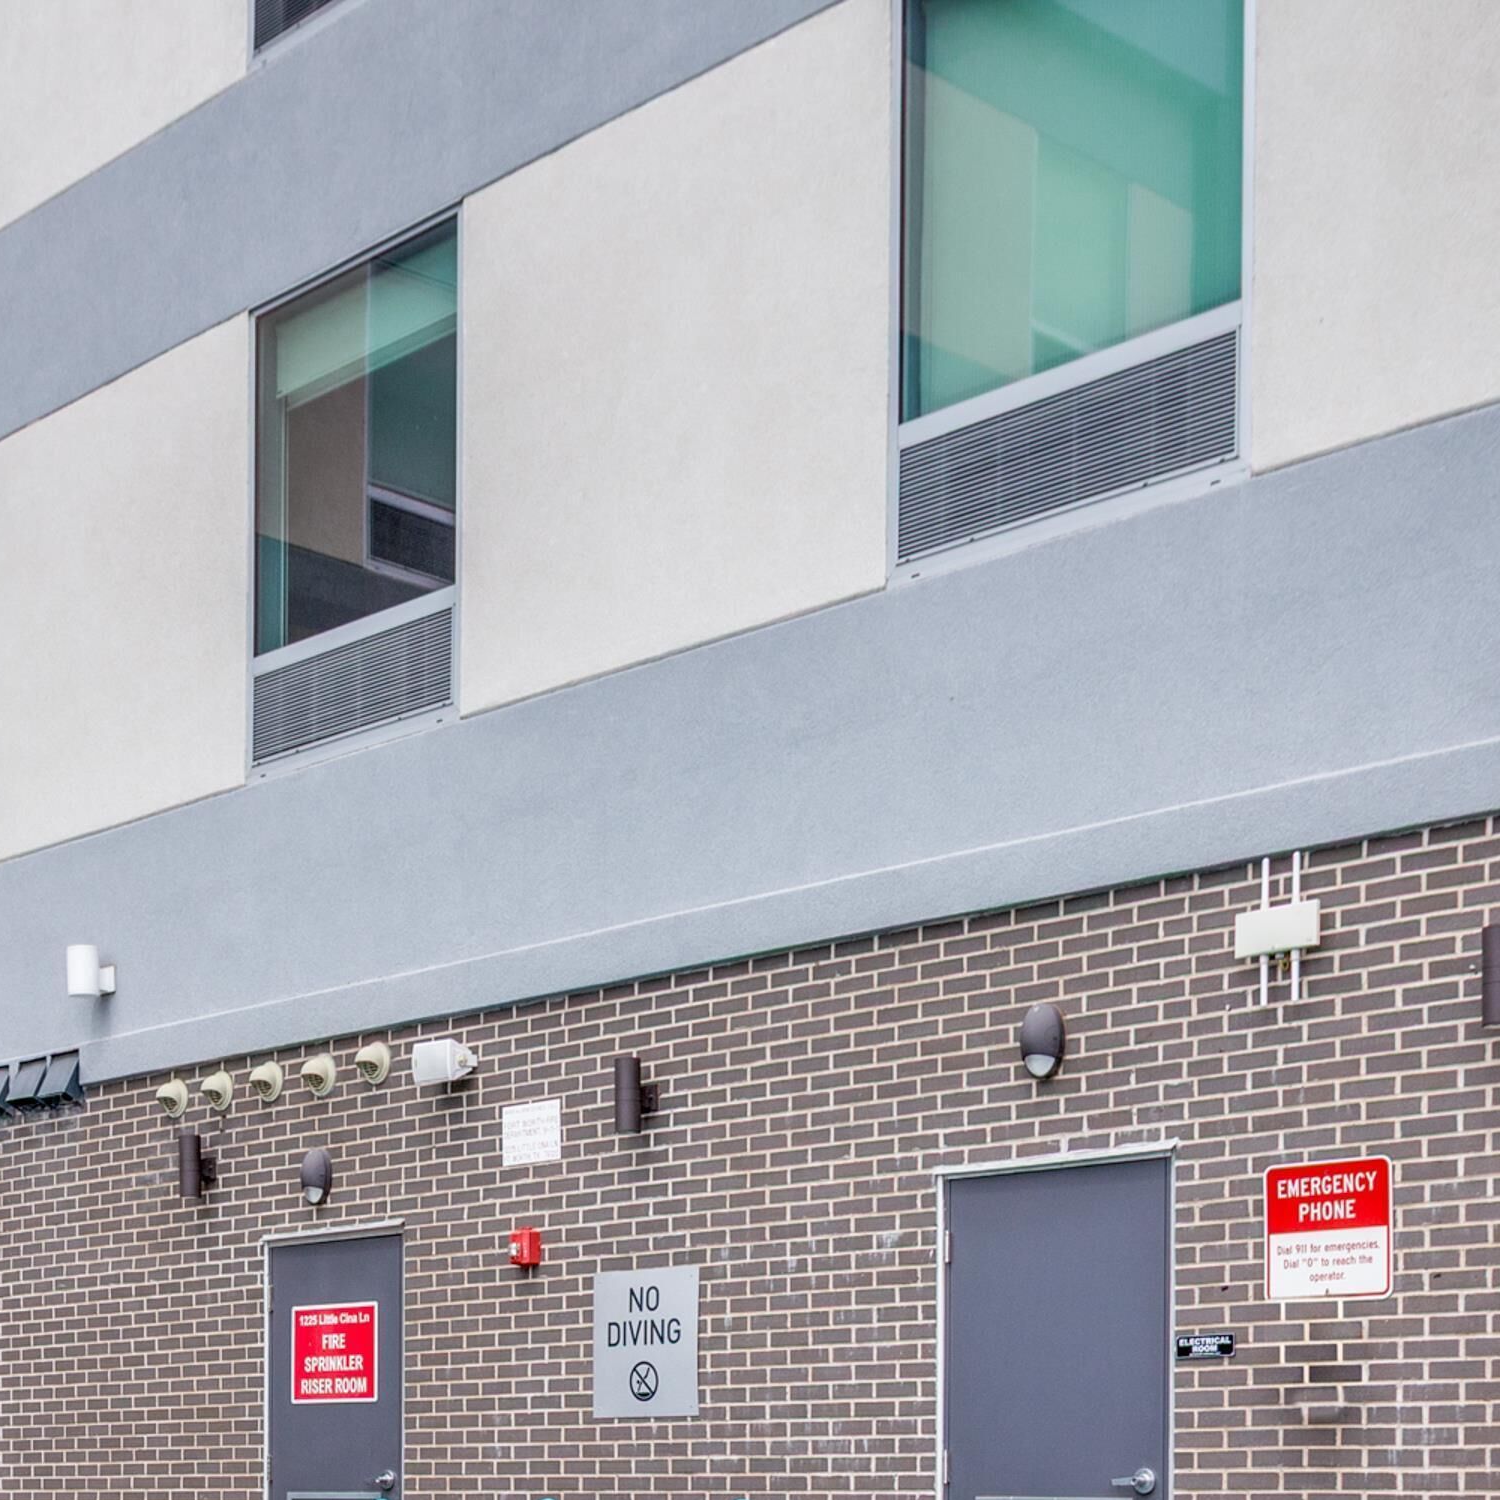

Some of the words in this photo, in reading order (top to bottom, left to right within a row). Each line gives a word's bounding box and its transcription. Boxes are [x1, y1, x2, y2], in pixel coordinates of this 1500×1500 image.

[1277, 1171, 1377, 1199] EMERGENCY
[1298, 1199, 1356, 1223] PHONE
[1277, 1245, 1292, 1256] Dial
[1295, 1243, 1307, 1253] 911
[1310, 1243, 1321, 1253] for
[1283, 1259, 1299, 1269] Dial
[1321, 1257, 1329, 1266] to
[1332, 1255, 1356, 1266] reach
[1359, 1255, 1373, 1264] the
[629, 1286, 660, 1313] NO
[358, 1311, 370, 1323] Ln
[322, 1333, 346, 1349] FIRE
[607, 1318, 682, 1347] DIVING
[1179, 1336, 1231, 1347] ELECTRICAL
[1192, 1345, 1218, 1353] ROOM
[304, 1354, 364, 1373] SPRINKLER
[300, 1378, 332, 1395] RISER
[335, 1376, 367, 1393] ROOM
